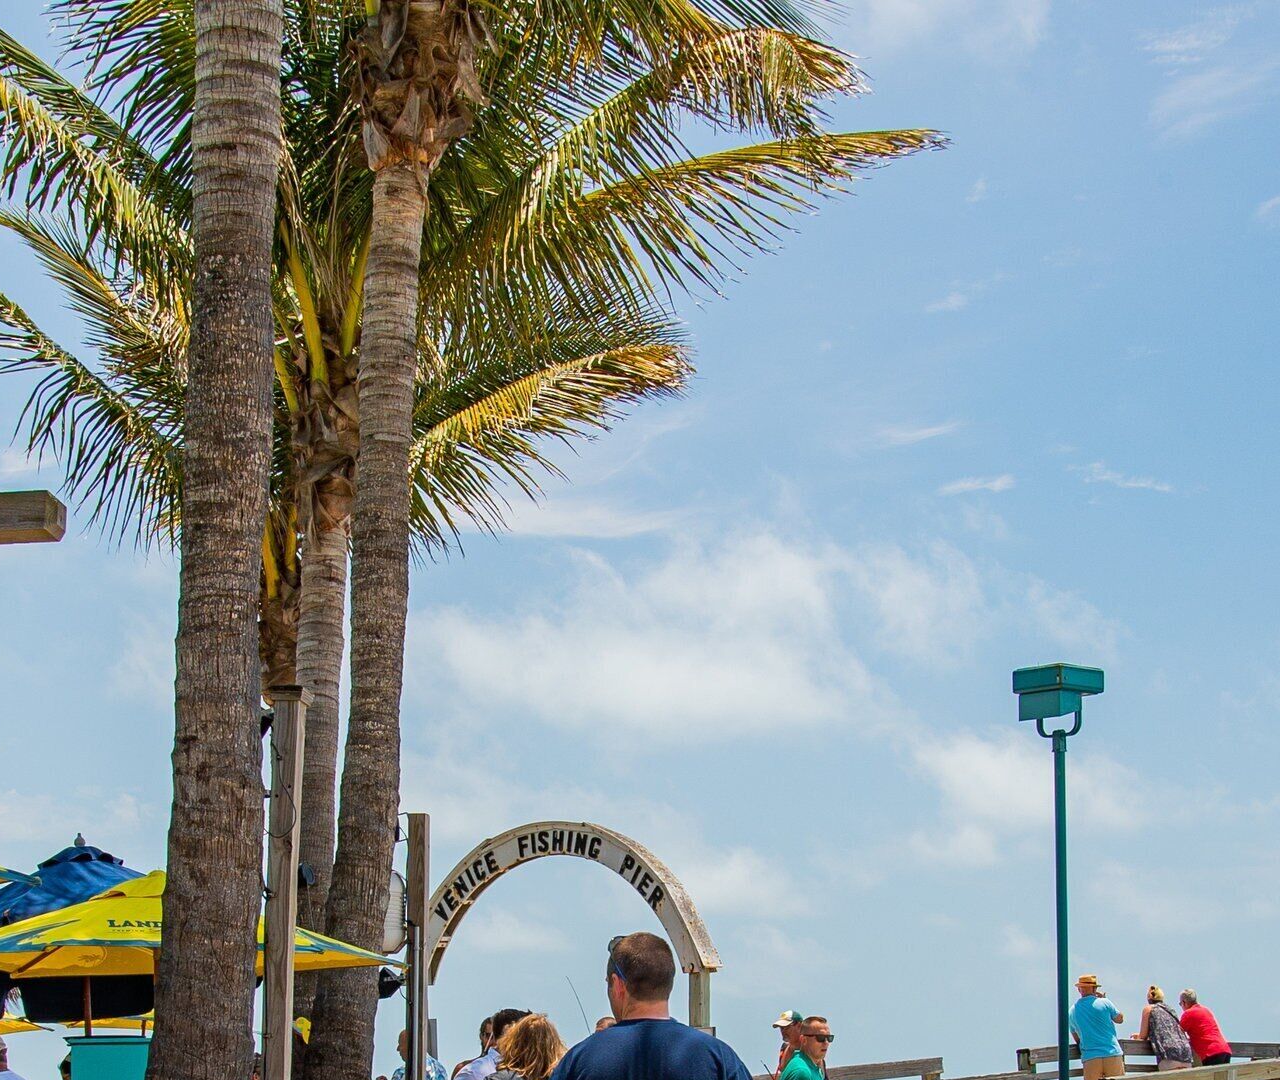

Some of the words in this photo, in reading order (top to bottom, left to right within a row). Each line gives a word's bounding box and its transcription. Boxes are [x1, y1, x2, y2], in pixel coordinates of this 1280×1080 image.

[434, 851, 499, 921] VENICE
[517, 830, 602, 859] FISHING
[619, 854, 664, 911] PIER
